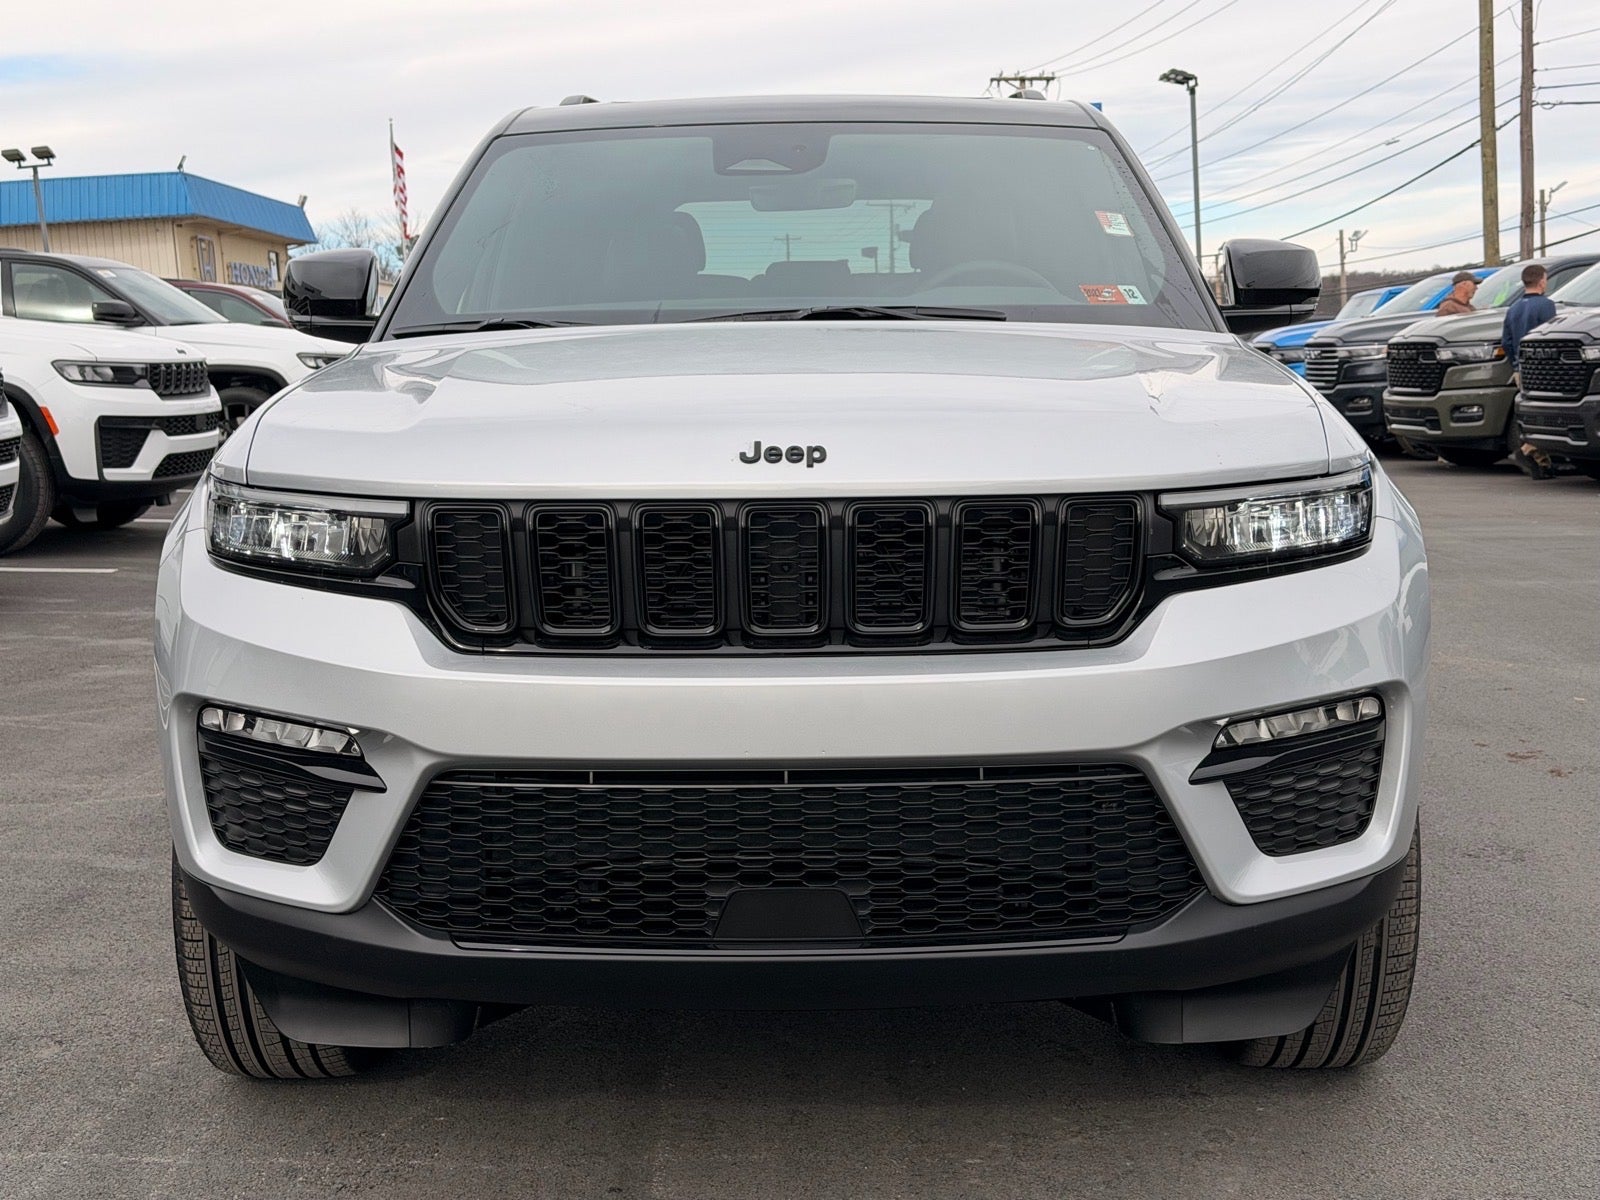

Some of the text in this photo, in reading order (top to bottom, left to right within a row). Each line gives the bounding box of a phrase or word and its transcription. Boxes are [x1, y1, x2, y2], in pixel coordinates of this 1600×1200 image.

[230, 261, 277, 288] HONDA
[1122, 288, 1139, 299] 12
[739, 441, 827, 468] Jeep
